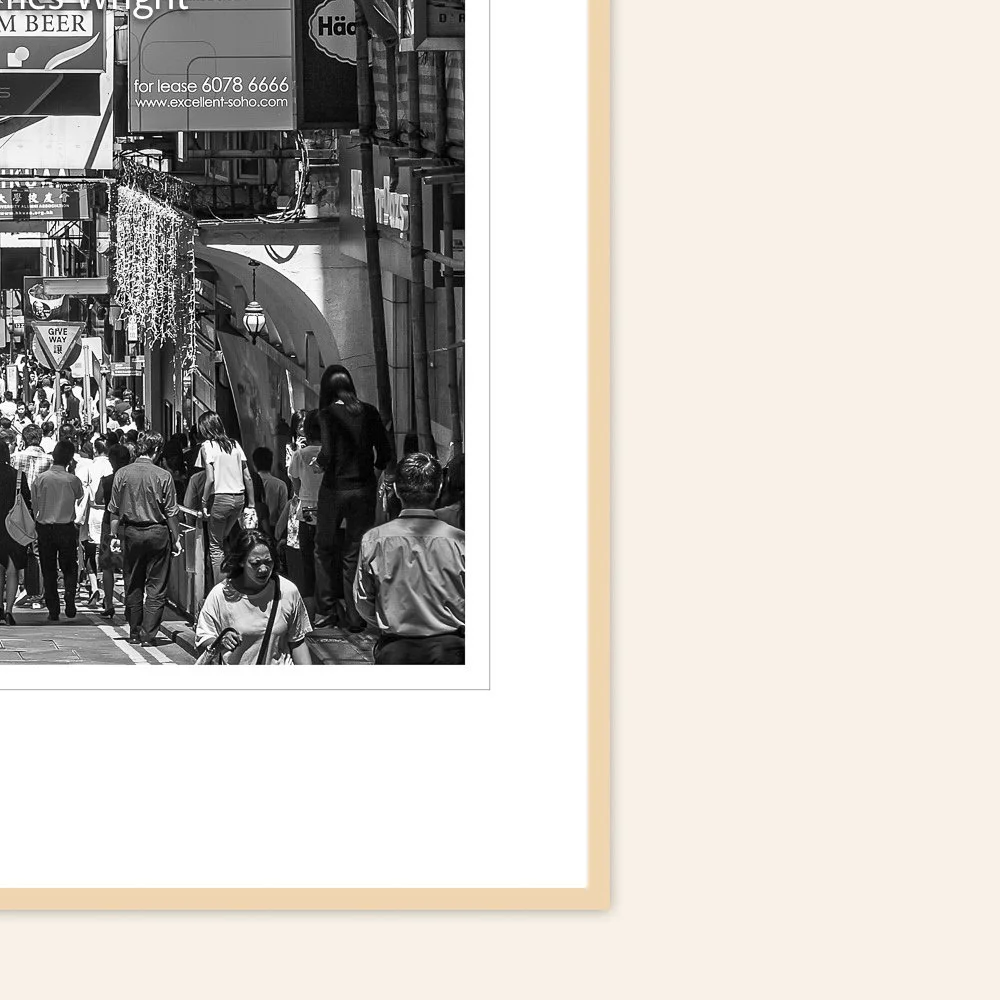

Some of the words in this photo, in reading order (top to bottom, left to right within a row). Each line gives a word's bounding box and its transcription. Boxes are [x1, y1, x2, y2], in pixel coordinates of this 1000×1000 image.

[25, 14, 86, 32] BEER
[133, 80, 154, 93] for
[157, 80, 197, 93] lease
[202, 77, 243, 93] 6078
[248, 77, 289, 93] 6666
[135, 97, 288, 108] www.excellent-soho.com
[47, 328, 68, 336] GIVE
